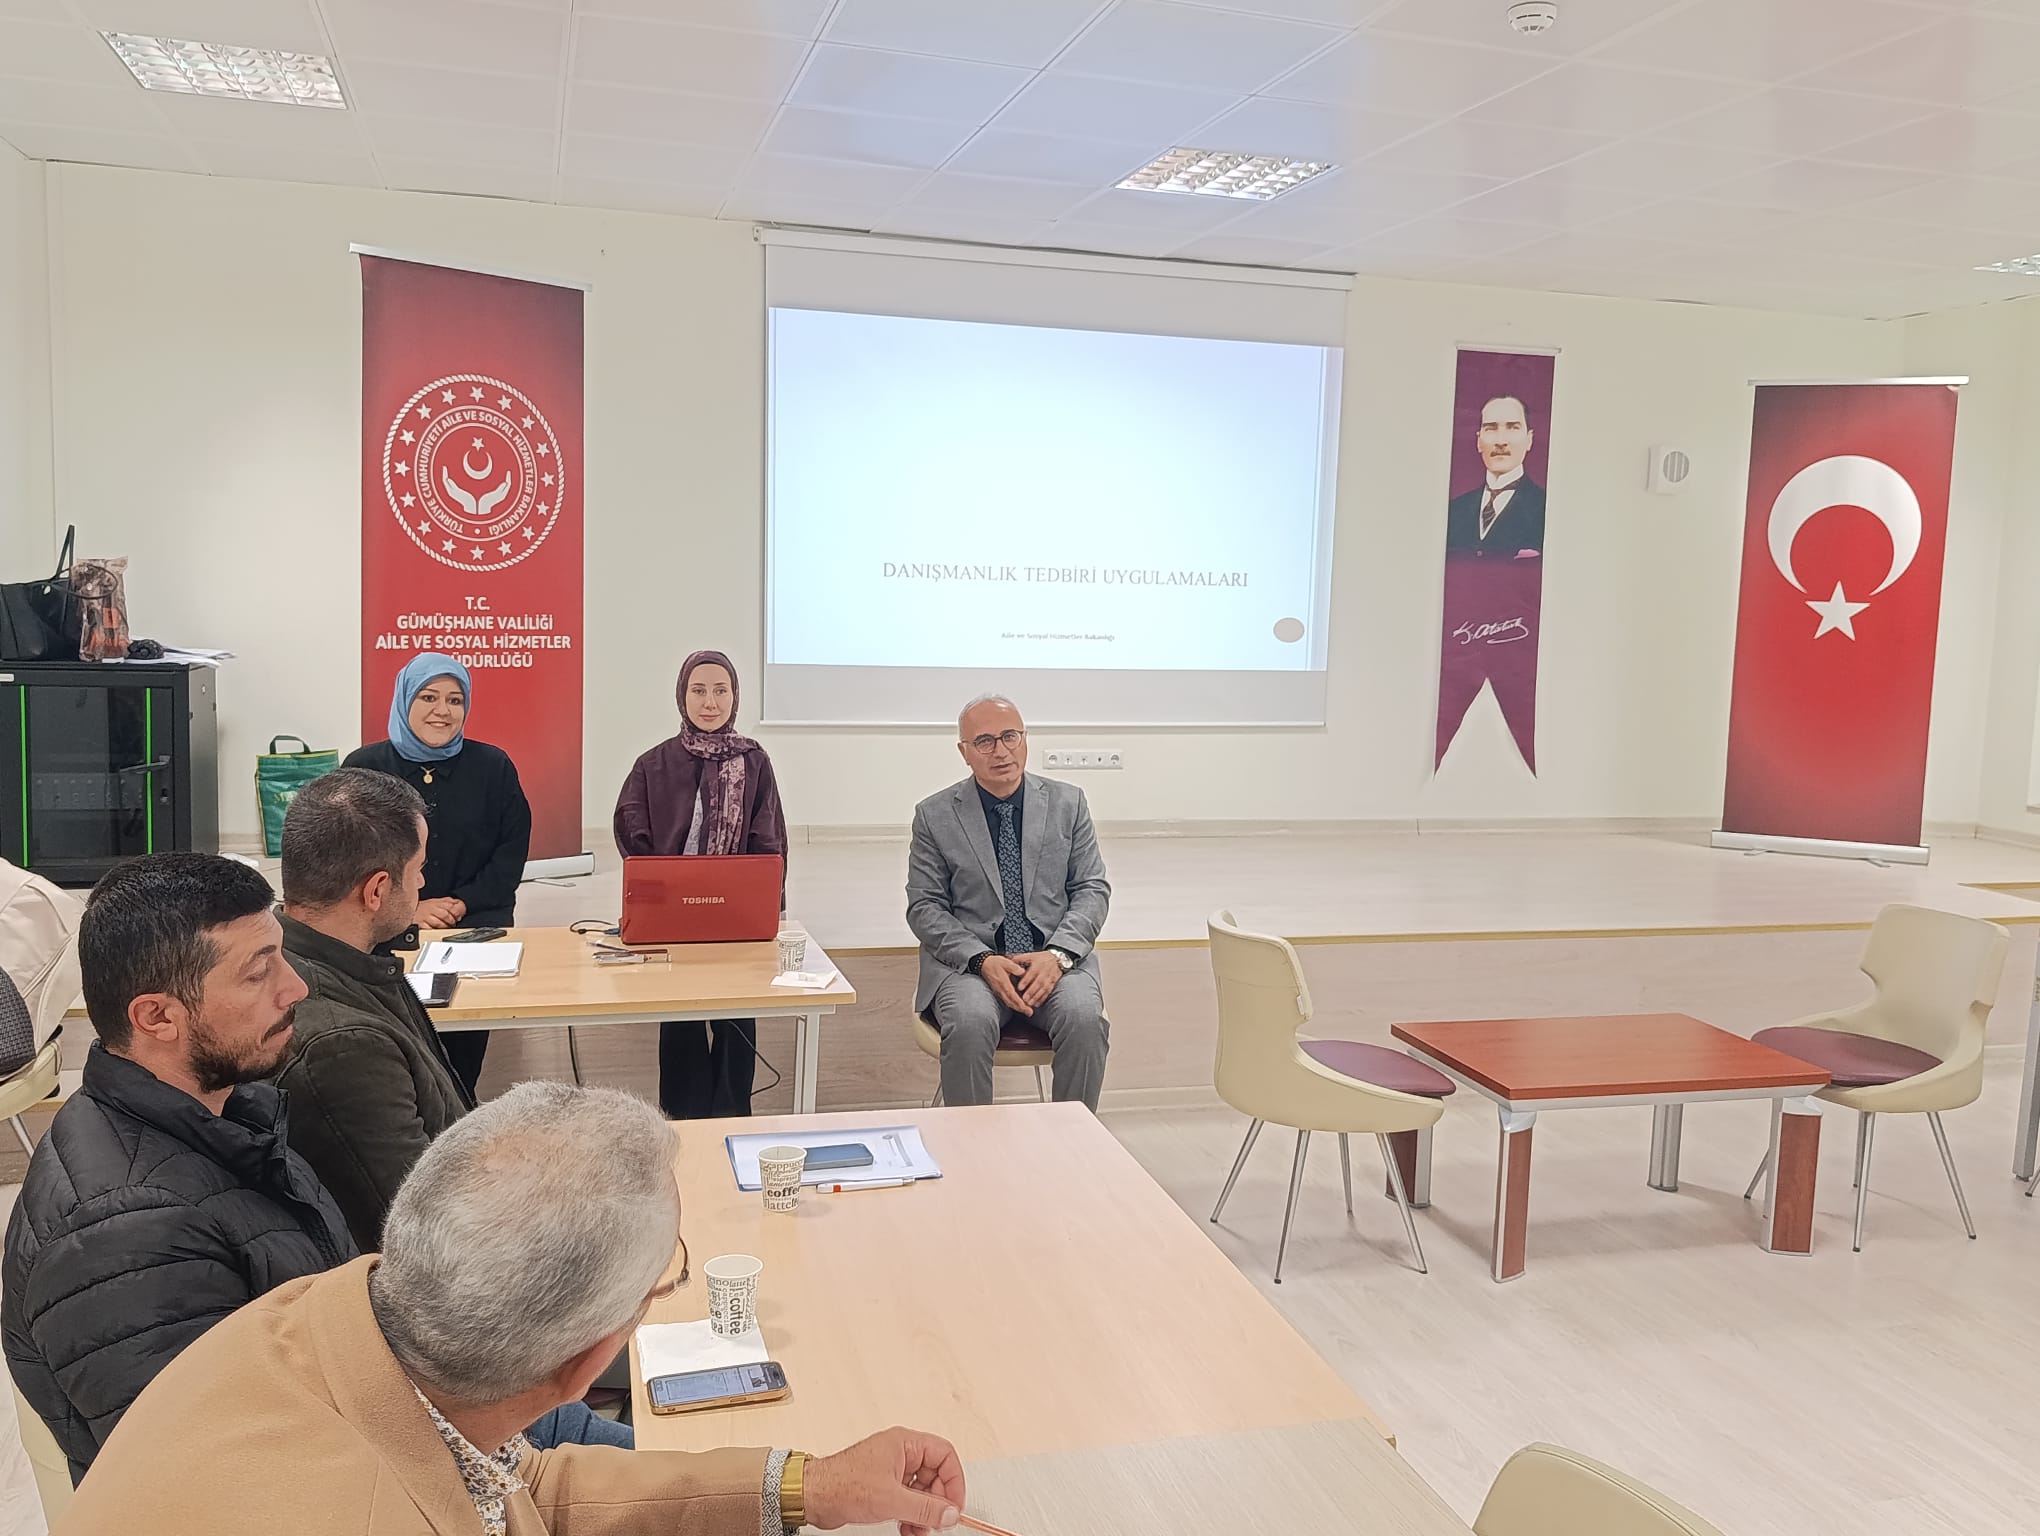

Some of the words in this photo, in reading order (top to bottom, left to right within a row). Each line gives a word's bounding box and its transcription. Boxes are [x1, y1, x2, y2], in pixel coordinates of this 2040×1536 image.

[441, 412, 463, 430] AİLE
[463, 410, 477, 421] VE
[478, 411, 514, 438] SOSYAL
[419, 423, 443, 498] CUMHURİYETİ
[512, 434, 534, 495] HİZMETLER
[488, 496, 531, 536] BAKANLIĞI
[882, 562, 1017, 583] DANIŞMANLIK
[1023, 566, 1097, 584] TEDBİRİ
[1102, 569, 1249, 588] UYGULAMALARI
[464, 596, 491, 611] T.C.
[396, 612, 494, 633] GÜMÜŞHANE
[497, 614, 554, 631] VALİLİĞİ
[375, 632, 410, 650] AİLE
[412, 635, 432, 649] VE
[435, 635, 490, 649] SOSYAL
[493, 633, 572, 649] HİZMETLER
[681, 896, 726, 905] TOSHIBA
[729, 1297, 743, 1336] coffee
